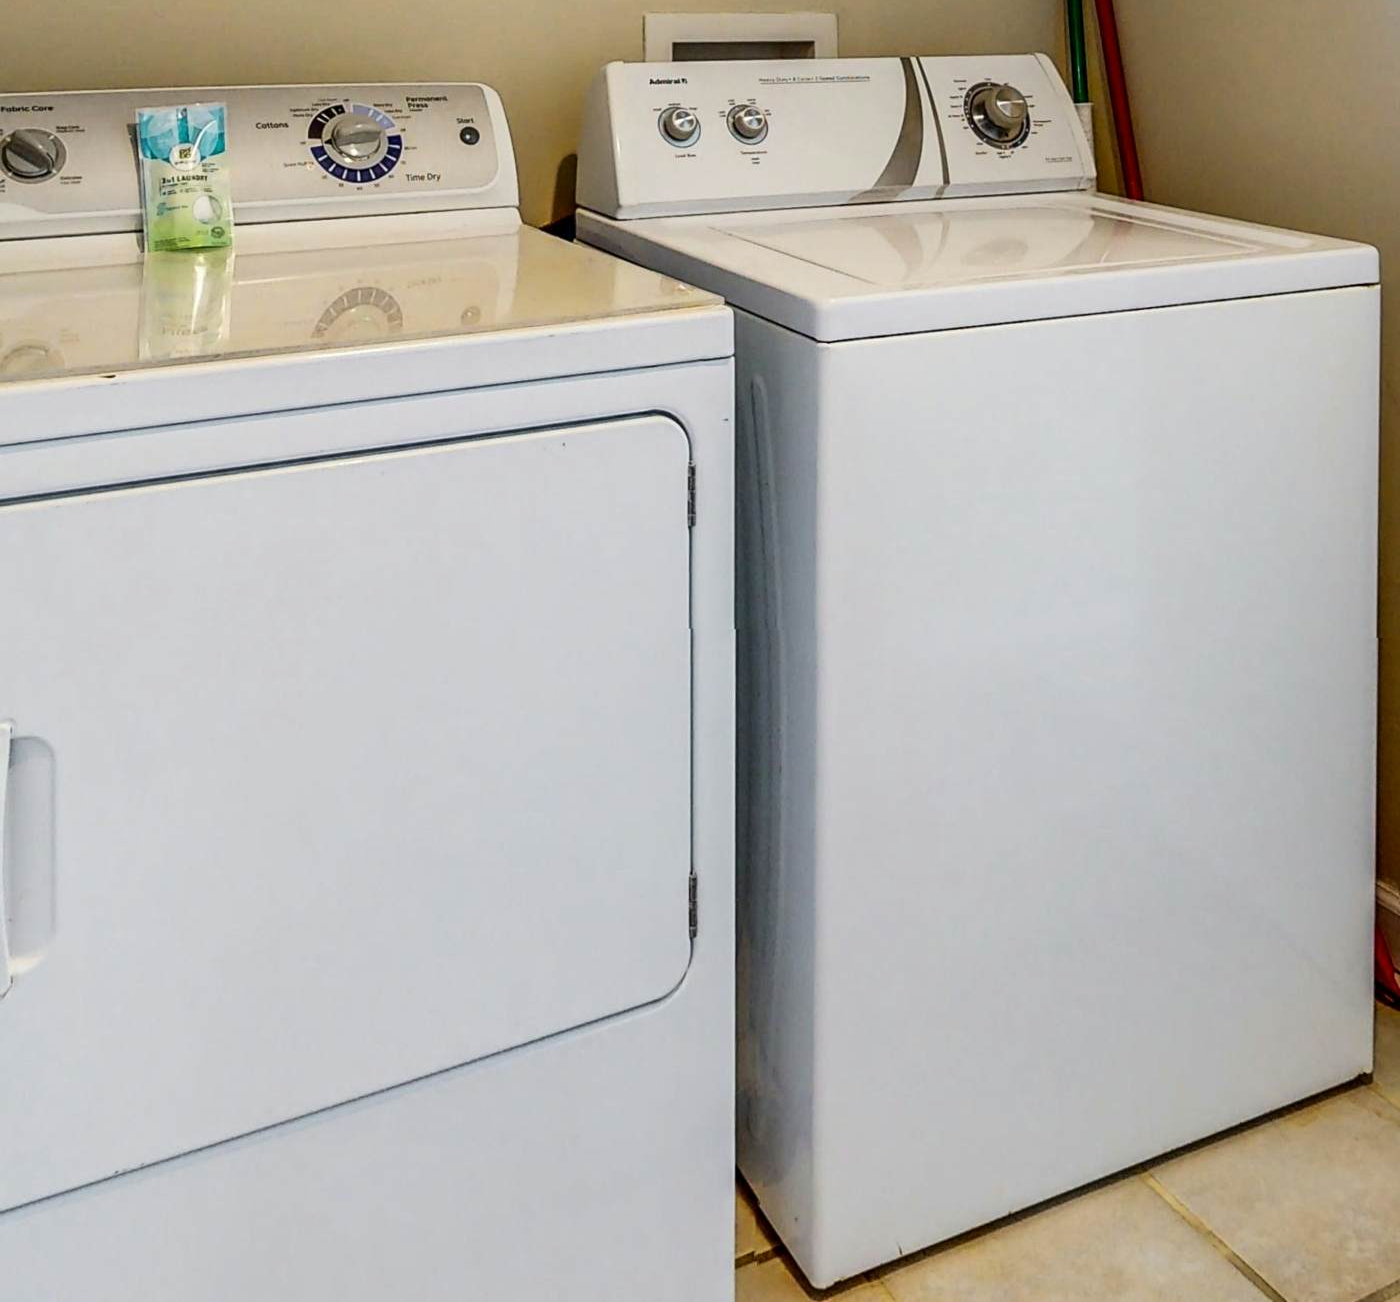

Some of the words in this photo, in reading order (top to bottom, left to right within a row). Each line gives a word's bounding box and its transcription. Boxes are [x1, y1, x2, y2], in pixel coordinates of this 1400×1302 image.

[255, 122, 289, 130] Cottons
[406, 173, 425, 181] Time
[427, 173, 441, 181] Dry
